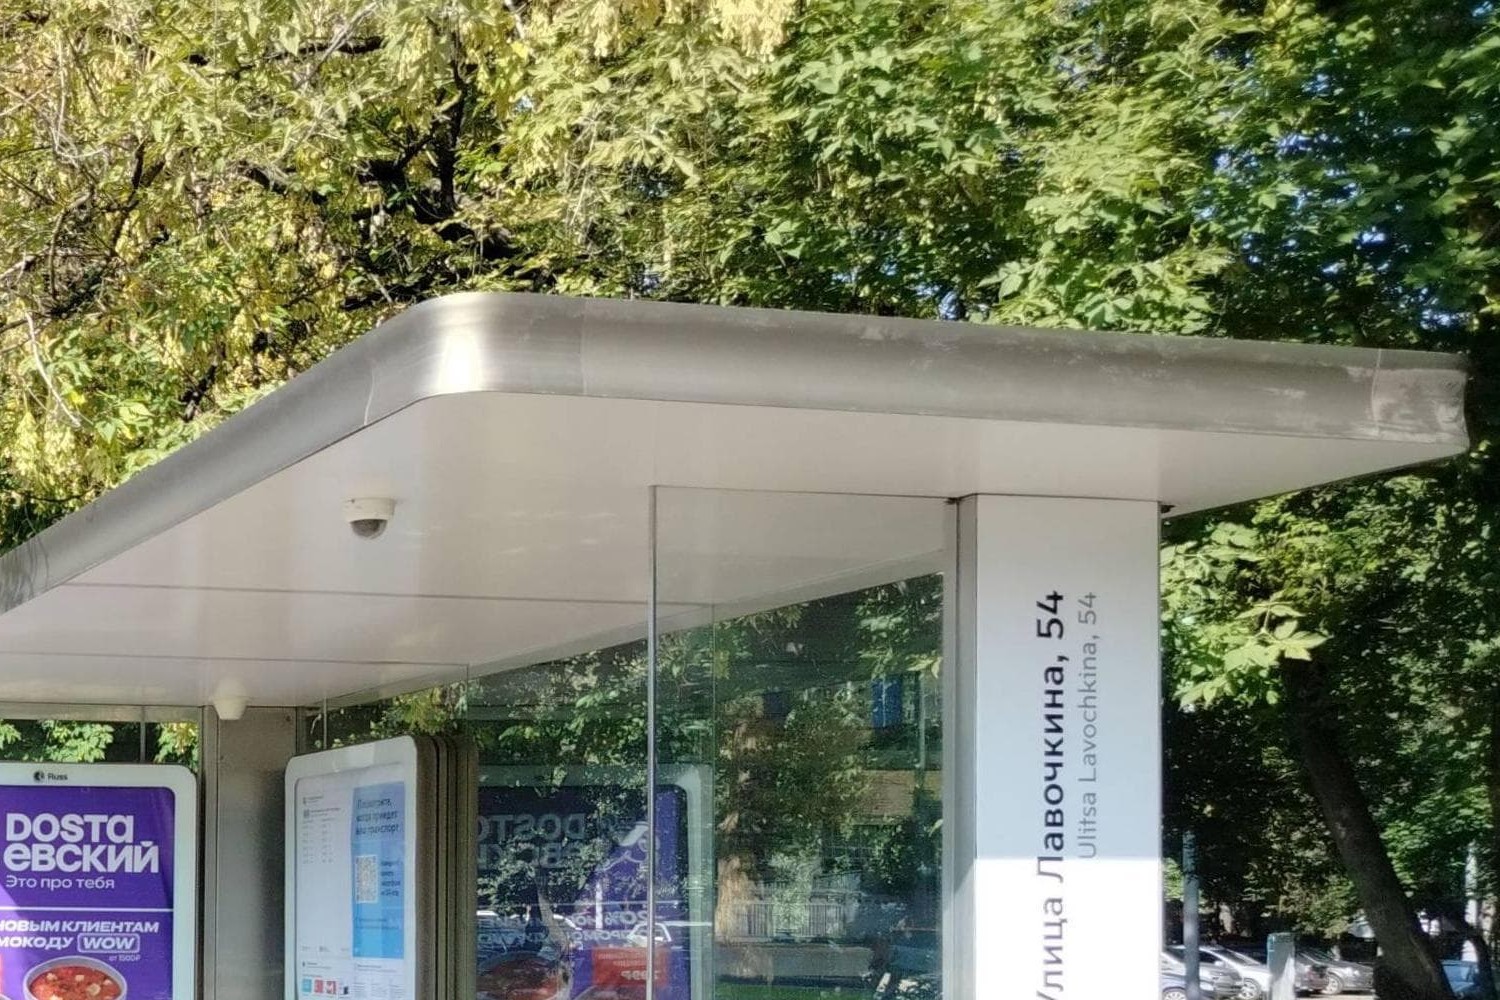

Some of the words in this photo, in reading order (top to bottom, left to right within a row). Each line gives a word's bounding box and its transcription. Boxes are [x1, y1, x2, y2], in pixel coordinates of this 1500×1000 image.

[1036, 590, 1065, 640] 54
[1077, 591, 1098, 626] 54
[1077, 633, 1100, 783] Lavochkina,
[47, 772, 69, 781] Russ
[1036, 655, 1070, 884] Лавочкина,
[1077, 792, 1098, 860] Ulitsa
[5, 875, 37, 888] Это
[40, 876, 73, 891] про
[76, 876, 115, 889] тебя
[62, 920, 160, 933] КЛИЕНТАМ
[82, 936, 137, 950] WOW
